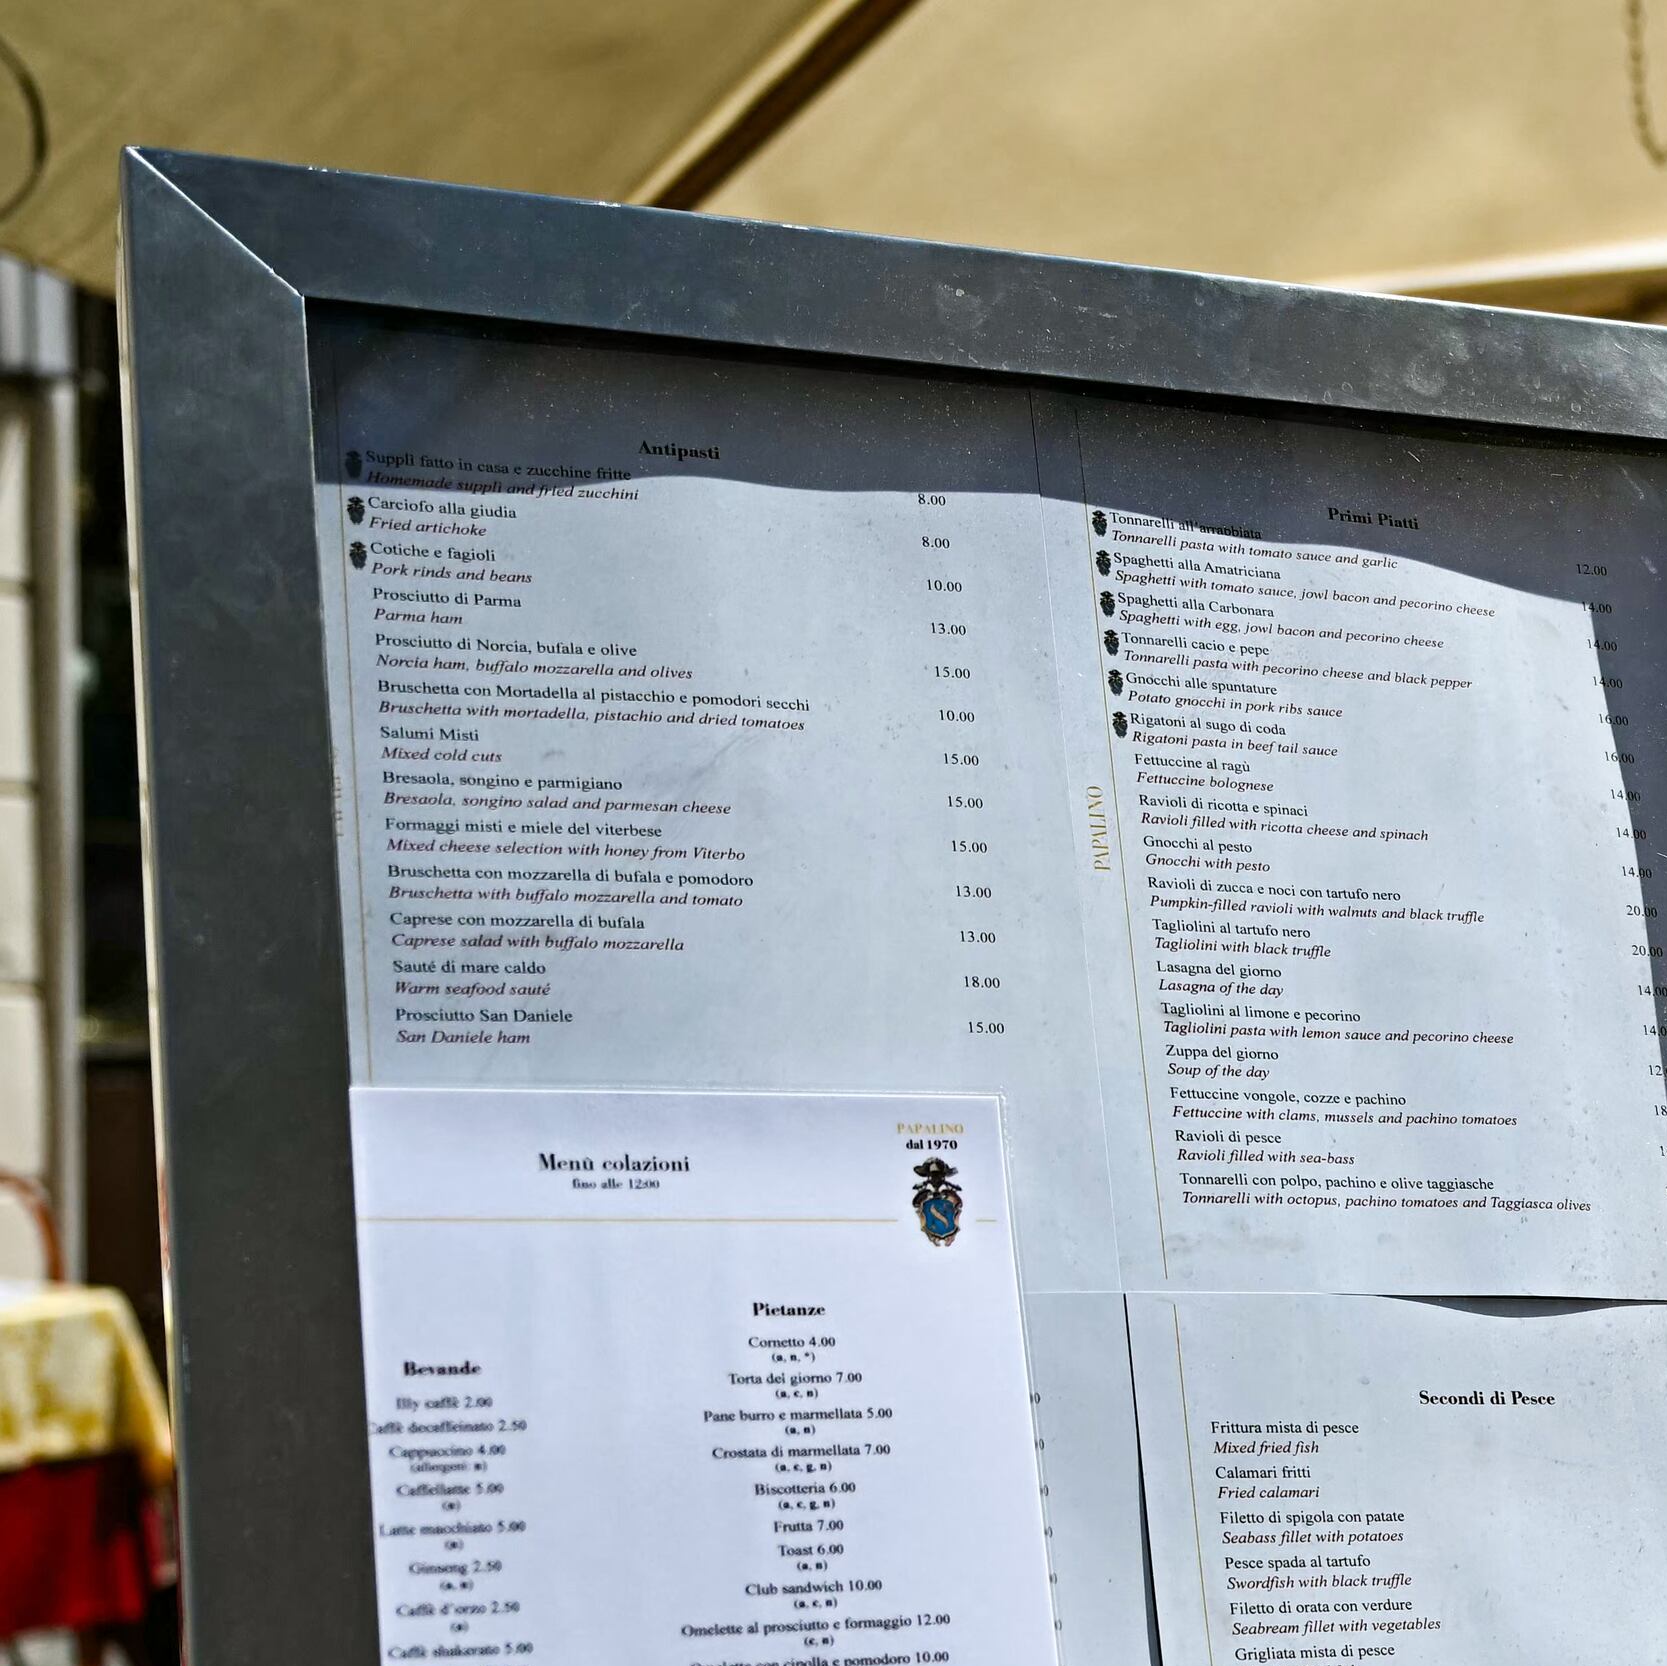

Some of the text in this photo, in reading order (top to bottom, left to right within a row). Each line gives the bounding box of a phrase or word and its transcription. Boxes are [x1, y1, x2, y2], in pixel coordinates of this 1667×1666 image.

[639, 441, 720, 461] Antipasti
[918, 494, 946, 506] 8.00
[368, 497, 516, 519] Carciofo alla giudia
[369, 516, 486, 536] Fried artichoke
[1327, 507, 1419, 530] Primi Piatti
[922, 537, 949, 548] 8.00
[370, 542, 495, 563] Cotiche e fagioli
[372, 562, 532, 583] Pork rinds and beans
[1575, 563, 1608, 578] 12.00
[928, 579, 962, 592] 10.00
[374, 588, 521, 607] Prosciutto di Parma
[1117, 592, 1274, 617] Spaghetti alla Carbonara
[932, 623, 966, 635] 13.00
[1121, 632, 1187, 648] Tonnarelli
[1192, 640, 1225, 651] cacio
[1240, 646, 1269, 657] pepe
[1126, 672, 1180, 687] Gnocchi
[1212, 682, 1277, 695] spuntature
[1128, 690, 1171, 704] Potato
[1175, 697, 1225, 708] gnocchi
[1245, 702, 1274, 713] pork
[1279, 703, 1302, 714] ribs
[1307, 708, 1342, 717] sauce
[1598, 713, 1630, 729] 16.00
[381, 726, 478, 741] Salumi Misti
[386, 818, 662, 837] Formaggi misti e miele del viterbese
[1086, 785, 1111, 871] PAPALINO
[952, 840, 987, 853] 15.00
[1625, 905, 1658, 920] 20.00
[1155, 937, 1331, 959] Tagliolini with black truffle
[396, 1008, 573, 1022] Prosciutto San Daniele
[1166, 1045, 1278, 1061] Zuppa del giorno
[1168, 1063, 1269, 1080] Soup of the day
[897, 1123, 964, 1135] PAPALINO
[906, 1139, 957, 1149] dal 1970
[1175, 1130, 1281, 1146] Ravioli di pesce
[603, 1154, 689, 1171] colazioni
[753, 1303, 825, 1316] Pietanze
[748, 1337, 835, 1348] Cornetto 4.00
[729, 1372, 862, 1387] Torta del giorno 7.00
[1419, 1390, 1555, 1405] Secondi di Pesce
[1211, 1421, 1358, 1436] Frittura mista di pesce
[1214, 1441, 1318, 1456] Mixed fried fish
[1216, 1466, 1310, 1479] Calamari fritti
[774, 1520, 844, 1533] Frutta 7.00
[778, 1544, 844, 1556] Toast 6.00
[745, 1580, 882, 1595] Club sandwich 10.00
